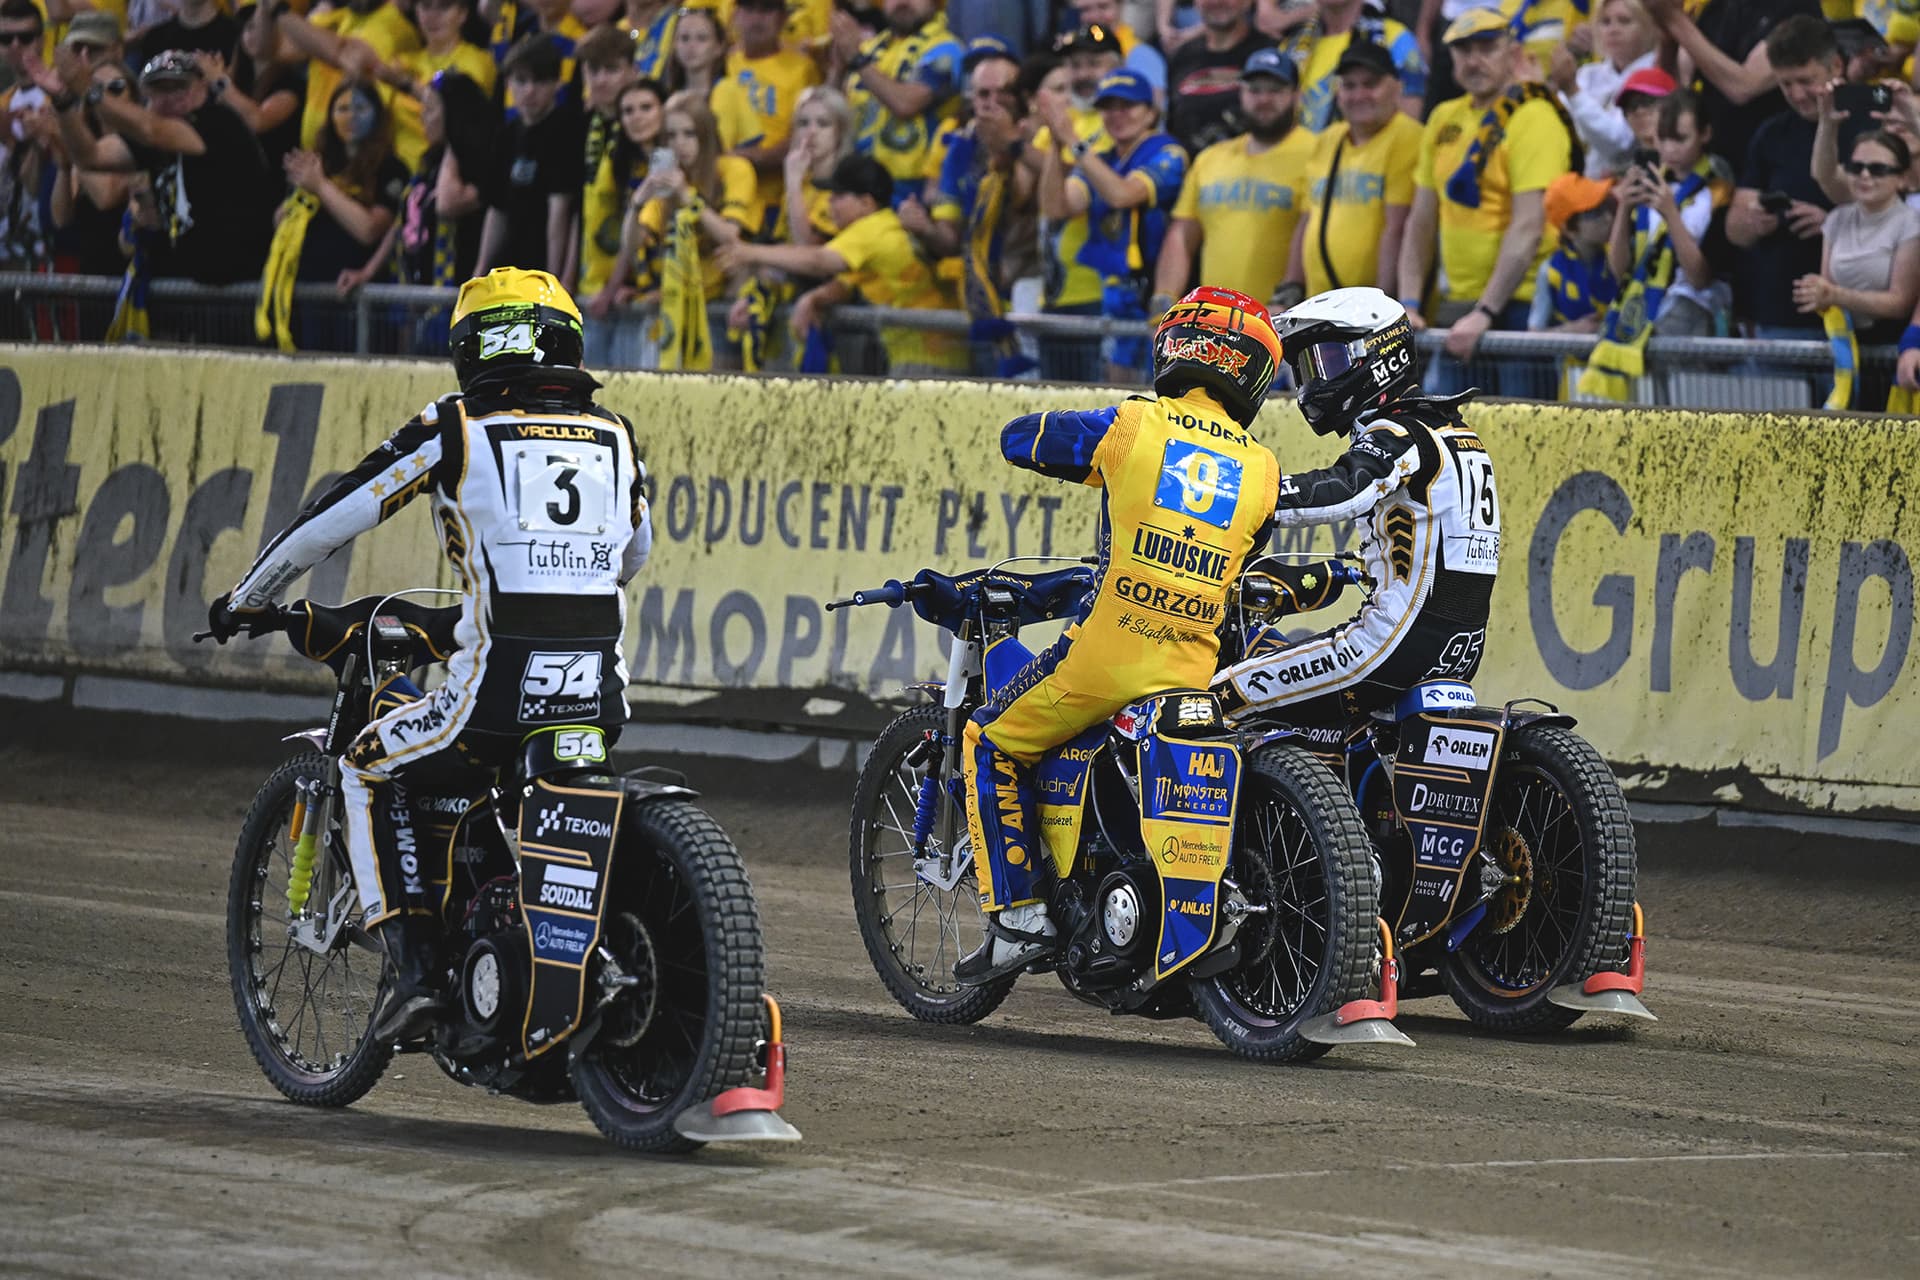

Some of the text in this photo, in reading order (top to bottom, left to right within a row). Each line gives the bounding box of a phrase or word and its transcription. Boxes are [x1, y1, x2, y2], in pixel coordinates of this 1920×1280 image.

[482, 322, 533, 357] 54
[1165, 337, 1252, 378] HOLDER
[1371, 348, 1410, 384] MCG
[517, 425, 597, 441] VACULIK
[1167, 412, 1248, 448] HOLDER
[546, 455, 581, 526] 3
[1182, 452, 1219, 514] 9
[0, 367, 360, 668] tech
[1132, 527, 1230, 581] LUBUSKIE
[1115, 575, 1220, 621] GORZÓW
[1527, 470, 1915, 765] Grup
[632, 586, 953, 696] MOPLA
[1438, 628, 1485, 675] 95
[523, 653, 602, 699] 54
[1278, 645, 1363, 685] ORLEN OIL
[549, 701, 598, 714] TEXOM
[1178, 702, 1213, 720] 25
[558, 732, 603, 758] 54
[1450, 739, 1489, 758] ORLEN
[1172, 782, 1228, 801] MONSTER
[1176, 800, 1223, 811] ENERGY
[1427, 791, 1481, 814] DRUTEX
[564, 816, 612, 839] TEXOM
[1421, 833, 1464, 857] MCG
[1179, 853, 1198, 864] AUTO
[539, 884, 593, 911] SOUDAL
[1180, 901, 1212, 916] ANLAS
